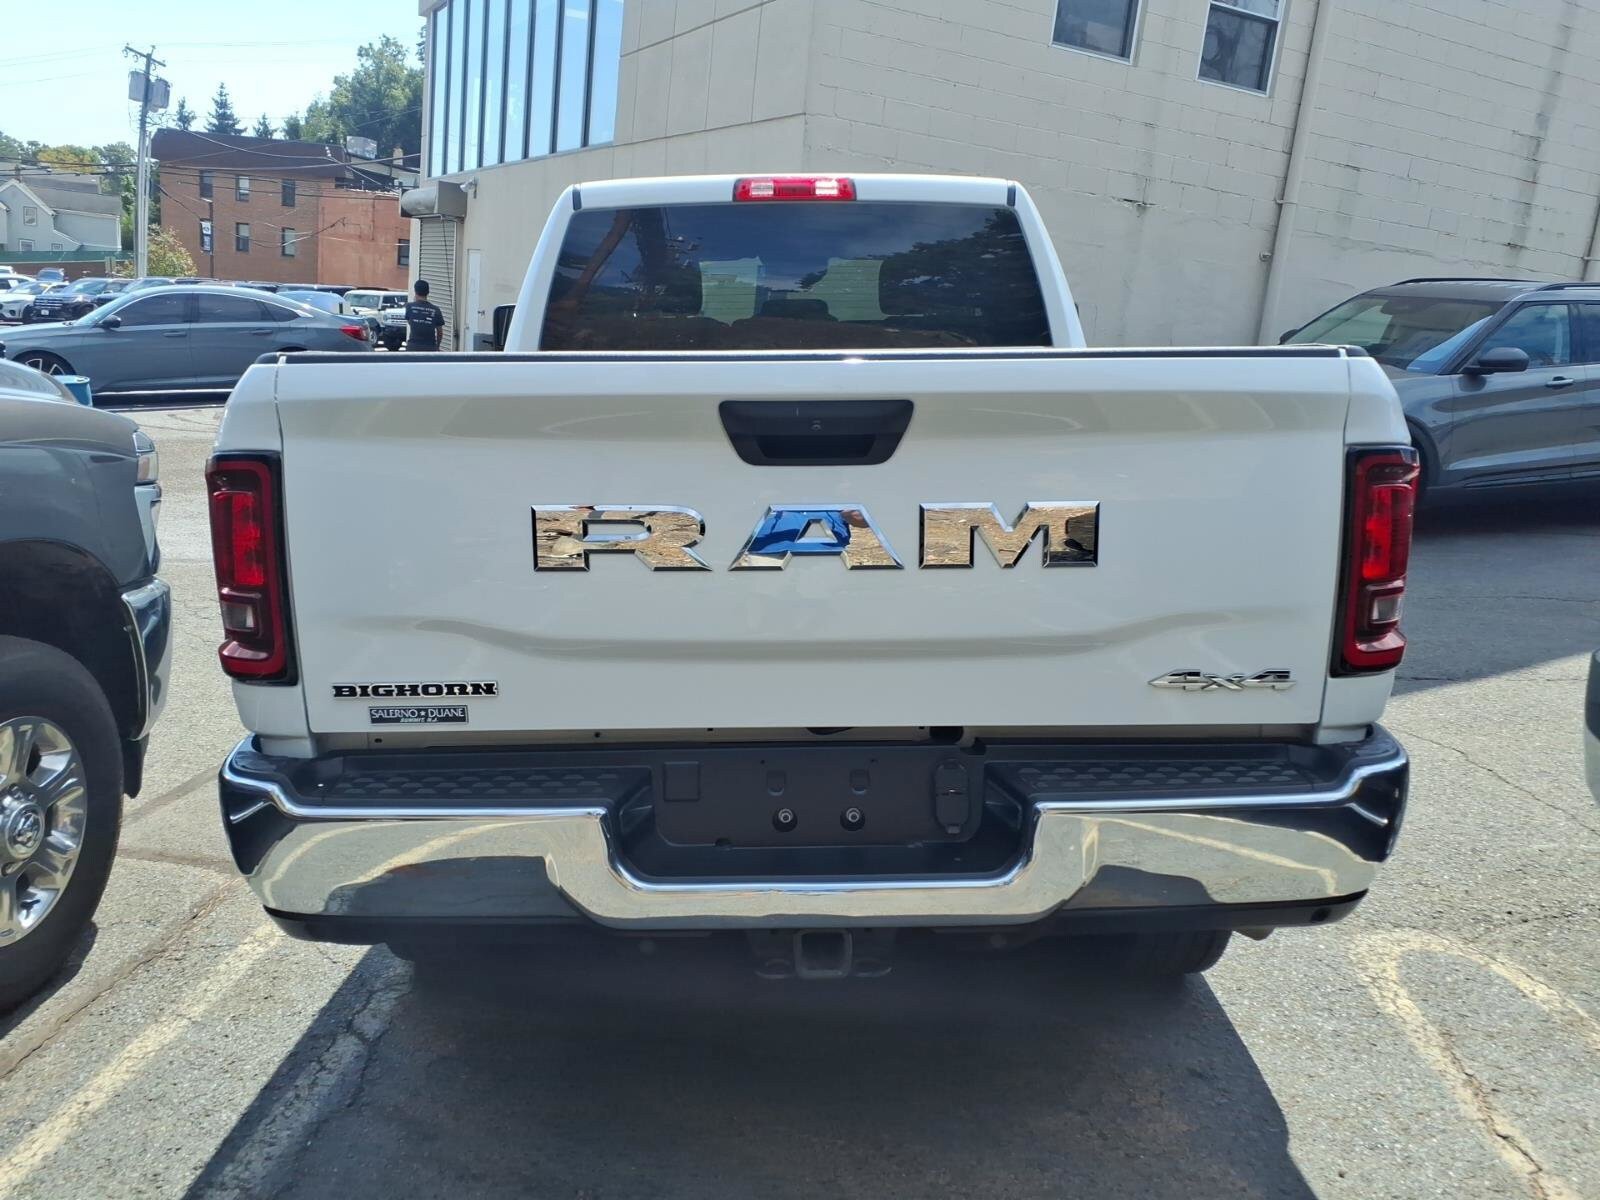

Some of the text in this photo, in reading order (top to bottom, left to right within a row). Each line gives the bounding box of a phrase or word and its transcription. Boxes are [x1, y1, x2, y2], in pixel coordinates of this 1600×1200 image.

[530, 501, 1100, 572] RAM
[332, 680, 498, 698] BIGHORN
[371, 708, 465, 719] SALERNO DUANE
